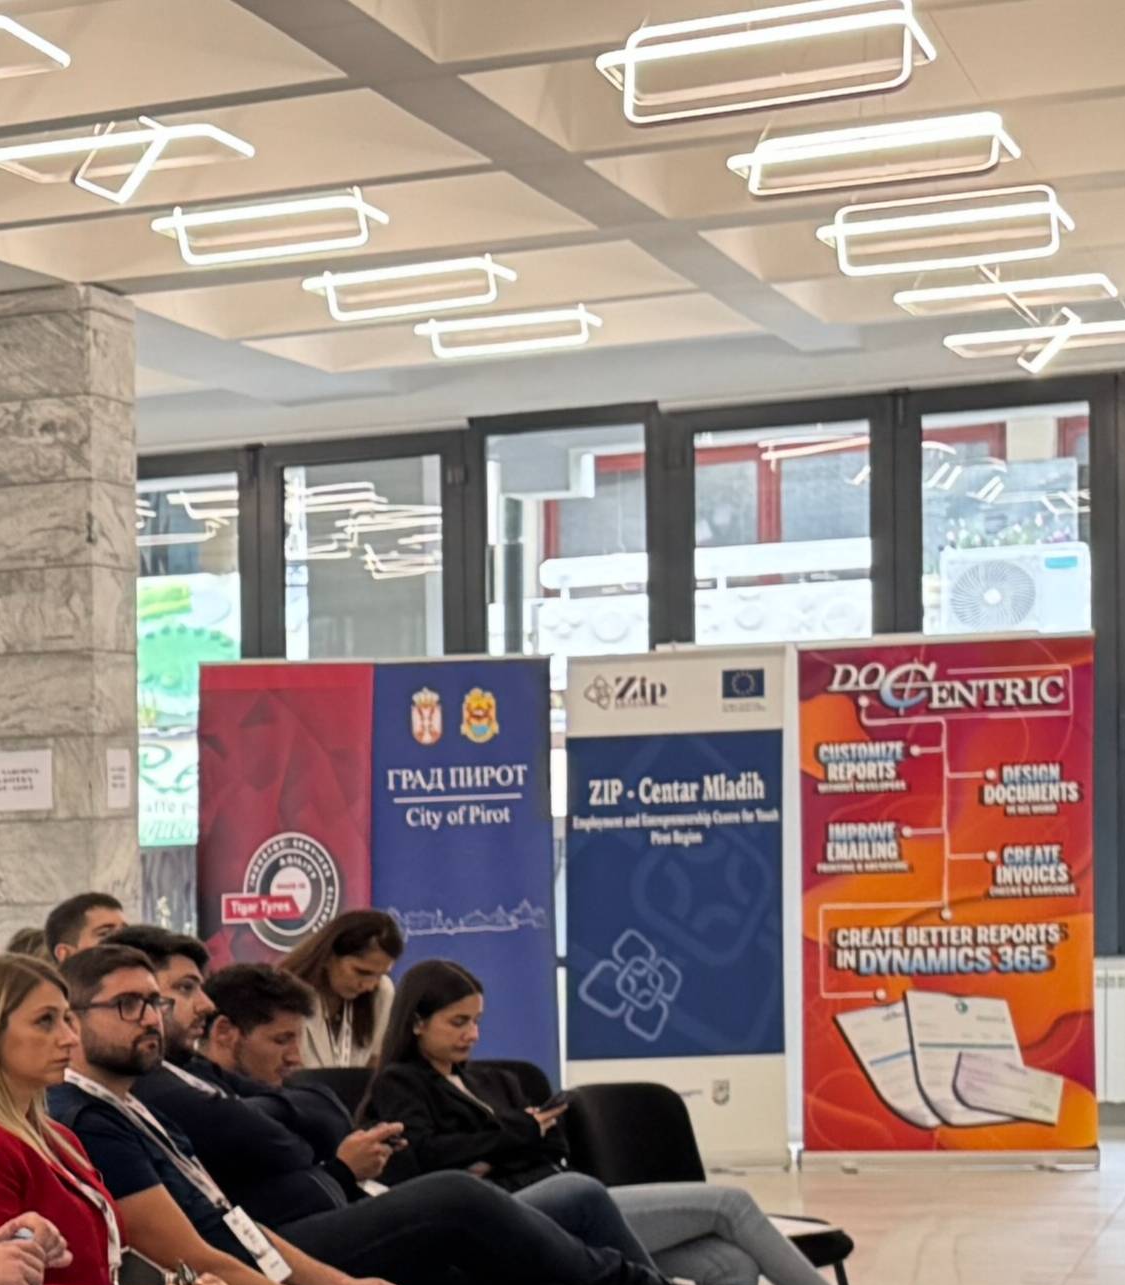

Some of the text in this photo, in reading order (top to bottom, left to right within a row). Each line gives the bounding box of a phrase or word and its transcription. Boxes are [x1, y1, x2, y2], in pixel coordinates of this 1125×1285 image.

[819, 741, 905, 763] CUSTOMIZE
[387, 764, 528, 792] ГРАД ПИРОТ
[828, 760, 897, 782] REPORTS
[1002, 762, 1060, 785] DESIGN
[588, 779, 624, 806] ZIP
[638, 777, 699, 804] Centar
[702, 772, 765, 801] Mladih
[983, 781, 1079, 805] DOCUMENTS
[406, 804, 511, 830] City of Pirot
[828, 821, 896, 843] IMPROVE
[826, 841, 899, 862] EMAILING
[1002, 844, 1062, 866] CREATE
[996, 862, 1069, 886] INVOICES
[836, 923, 1060, 948] CREATE BETTER REPORTS
[836, 944, 1049, 975] IN DYNAMICS 365
